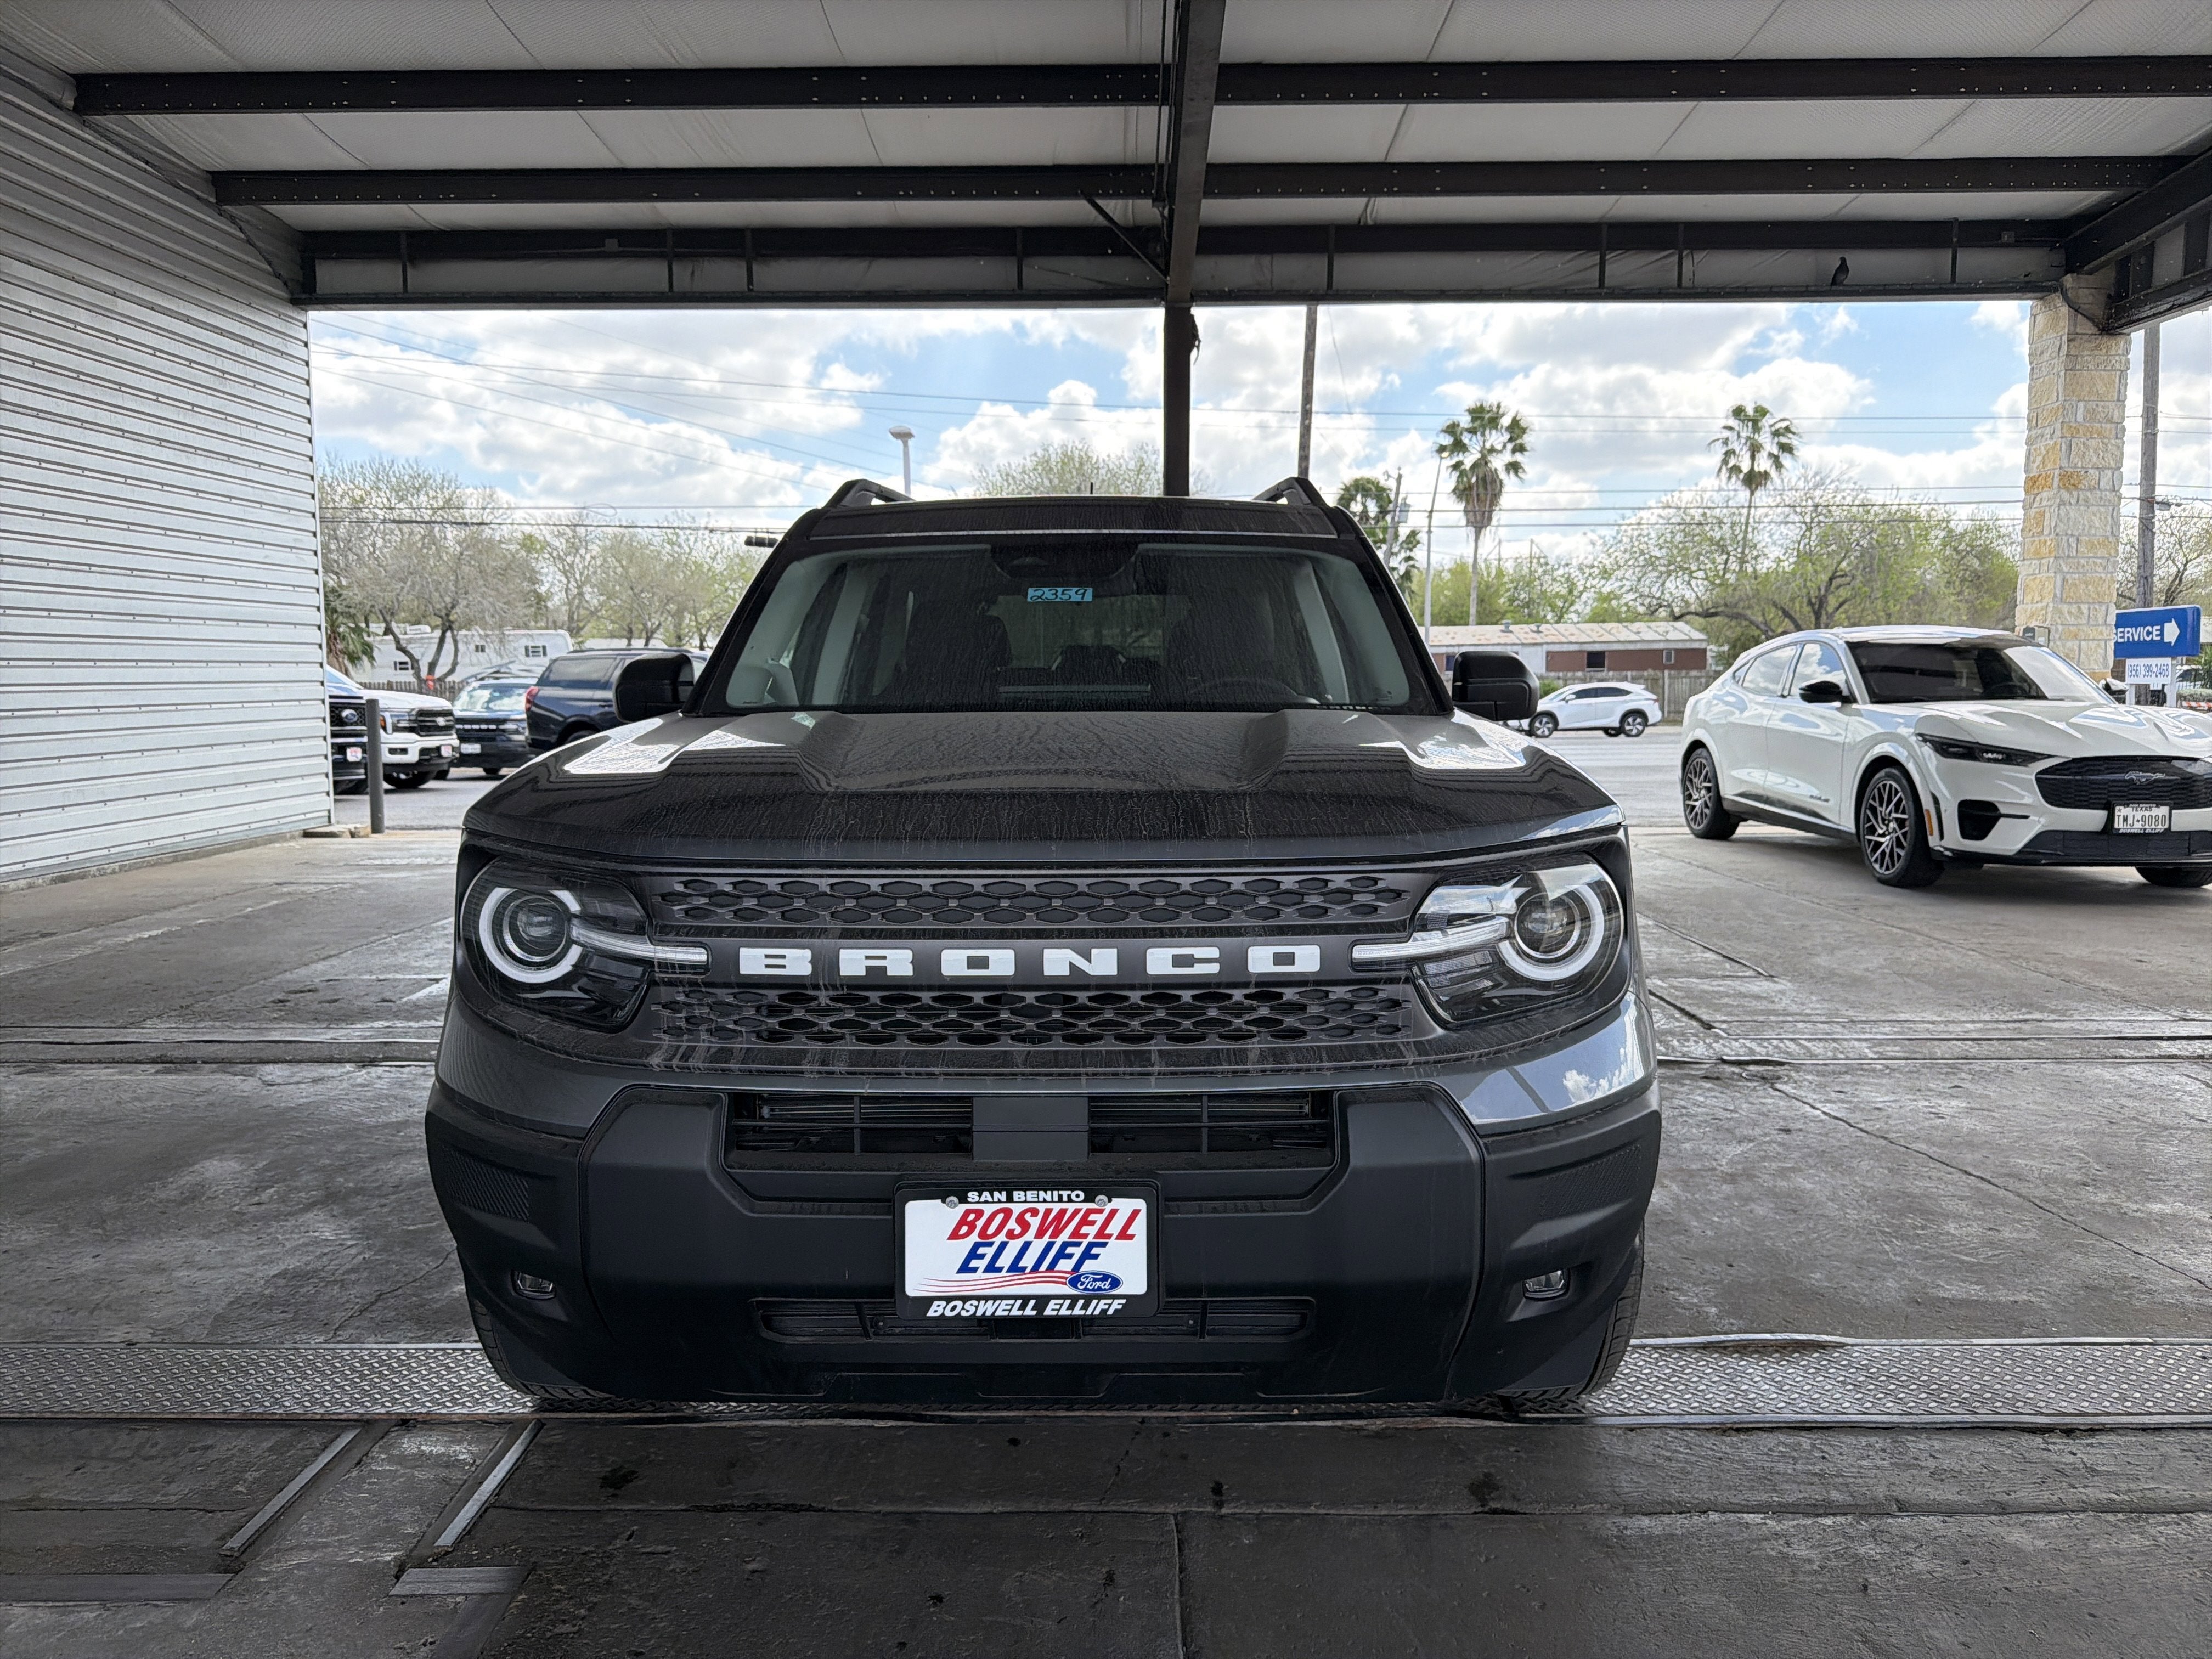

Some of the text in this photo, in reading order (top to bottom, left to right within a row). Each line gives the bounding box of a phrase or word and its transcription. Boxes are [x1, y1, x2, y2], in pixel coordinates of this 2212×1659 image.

[1030, 588, 1087, 601] 2359
[2128, 663, 2169, 678] (956) 399-2468
[739, 944, 1321, 977] BRONCO
[967, 1190, 1085, 1203] SAN BENITO
[946, 1207, 1142, 1241] BOSWELL
[955, 1240, 1109, 1274] ELLIFF
[1077, 1274, 1111, 1290] Ford
[926, 1299, 1127, 1317] BOSWELL ELLIFF
